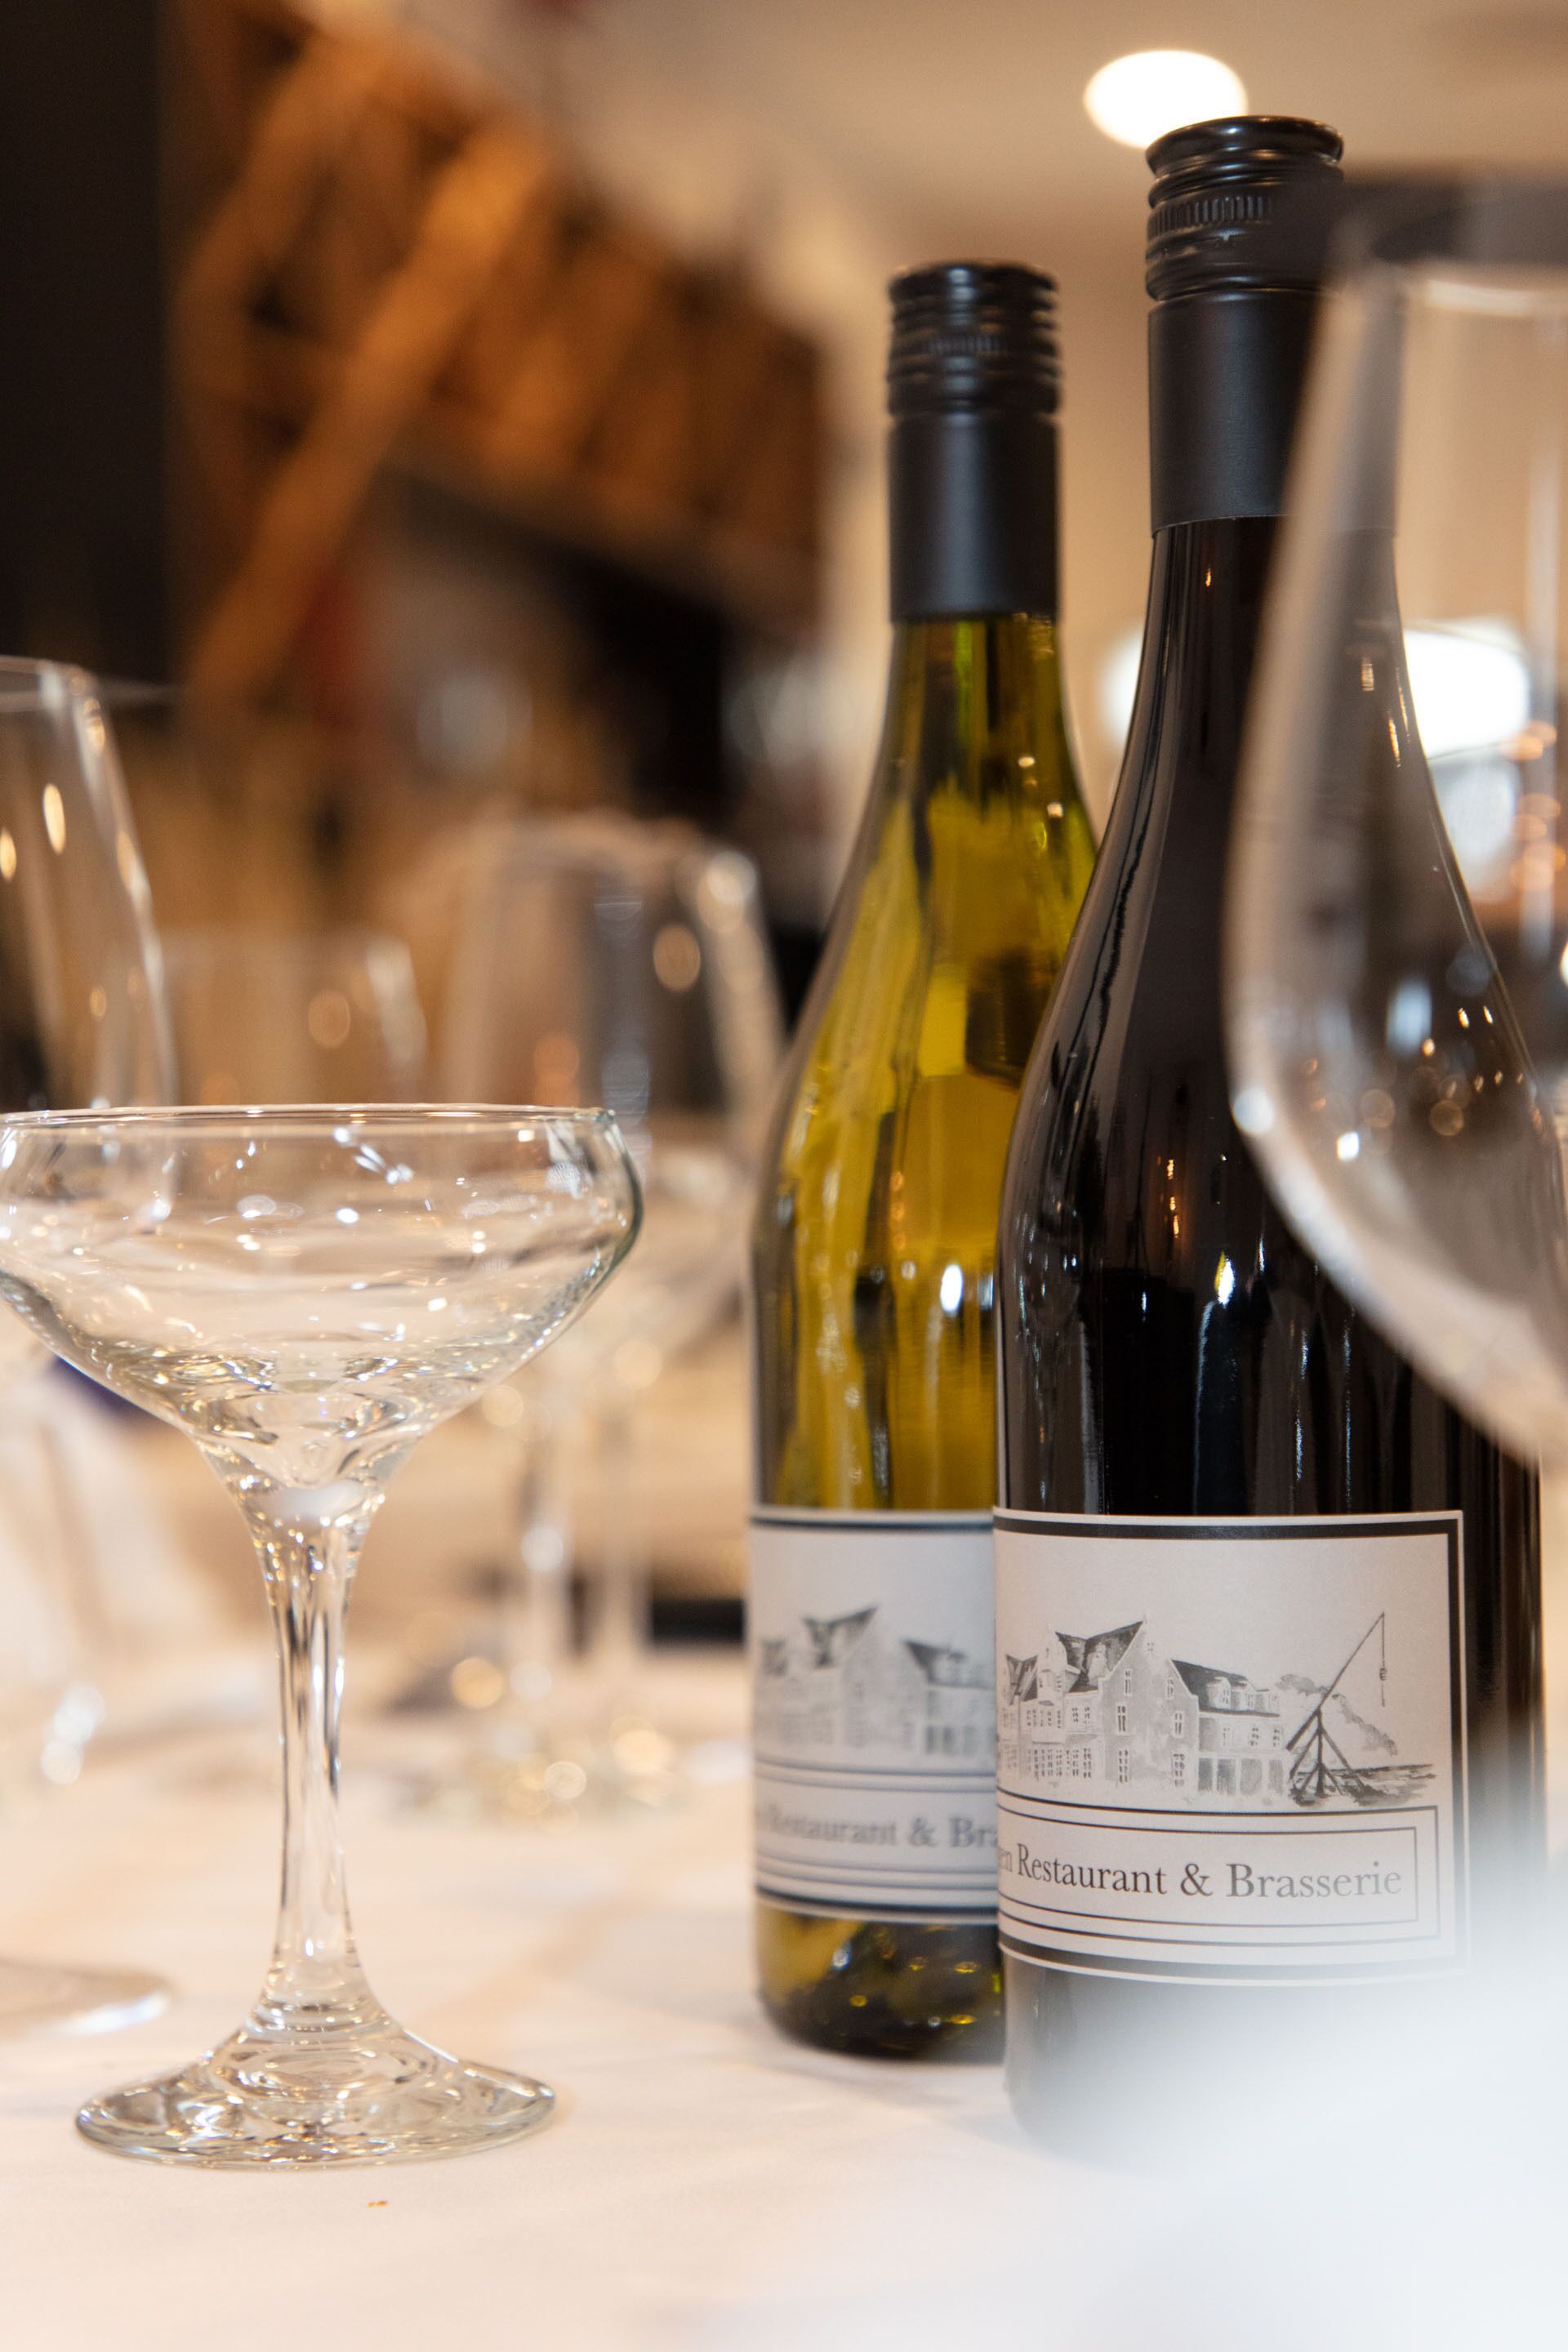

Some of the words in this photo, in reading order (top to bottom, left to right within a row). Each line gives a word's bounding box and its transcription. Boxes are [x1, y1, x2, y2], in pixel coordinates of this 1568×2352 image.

[907, 1816, 935, 1847] &
[1017, 1843, 1166, 1895] Restaurant
[1181, 1863, 1213, 1896] &
[1226, 1861, 1401, 1898] Brasserie
